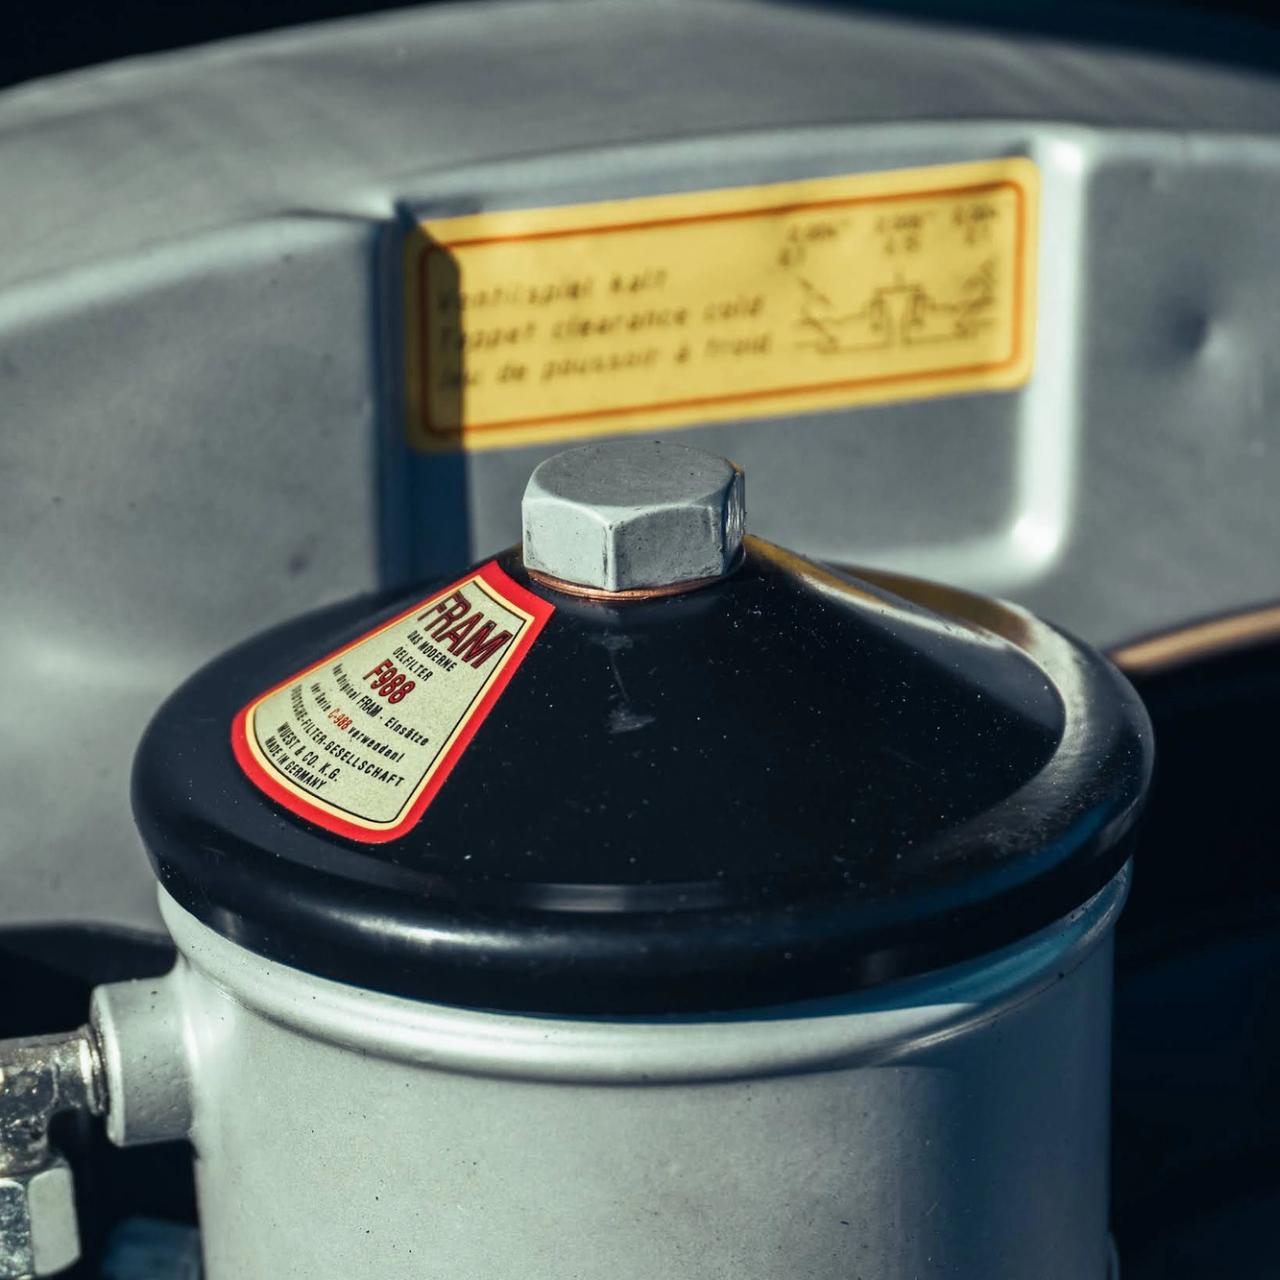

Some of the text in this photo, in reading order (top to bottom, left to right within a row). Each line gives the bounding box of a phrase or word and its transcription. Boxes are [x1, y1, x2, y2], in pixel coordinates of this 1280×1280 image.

[552, 308, 688, 341] clearance
[417, 590, 514, 670] FRAM
[392, 646, 434, 682] OELFILTER
[418, 640, 458, 674] MODERNE
[362, 658, 416, 704] F988
[356, 695, 383, 718] FRAM
[277, 721, 301, 750] WUEST
[265, 735, 282, 758] MADE
[284, 758, 328, 791] GERMANY
